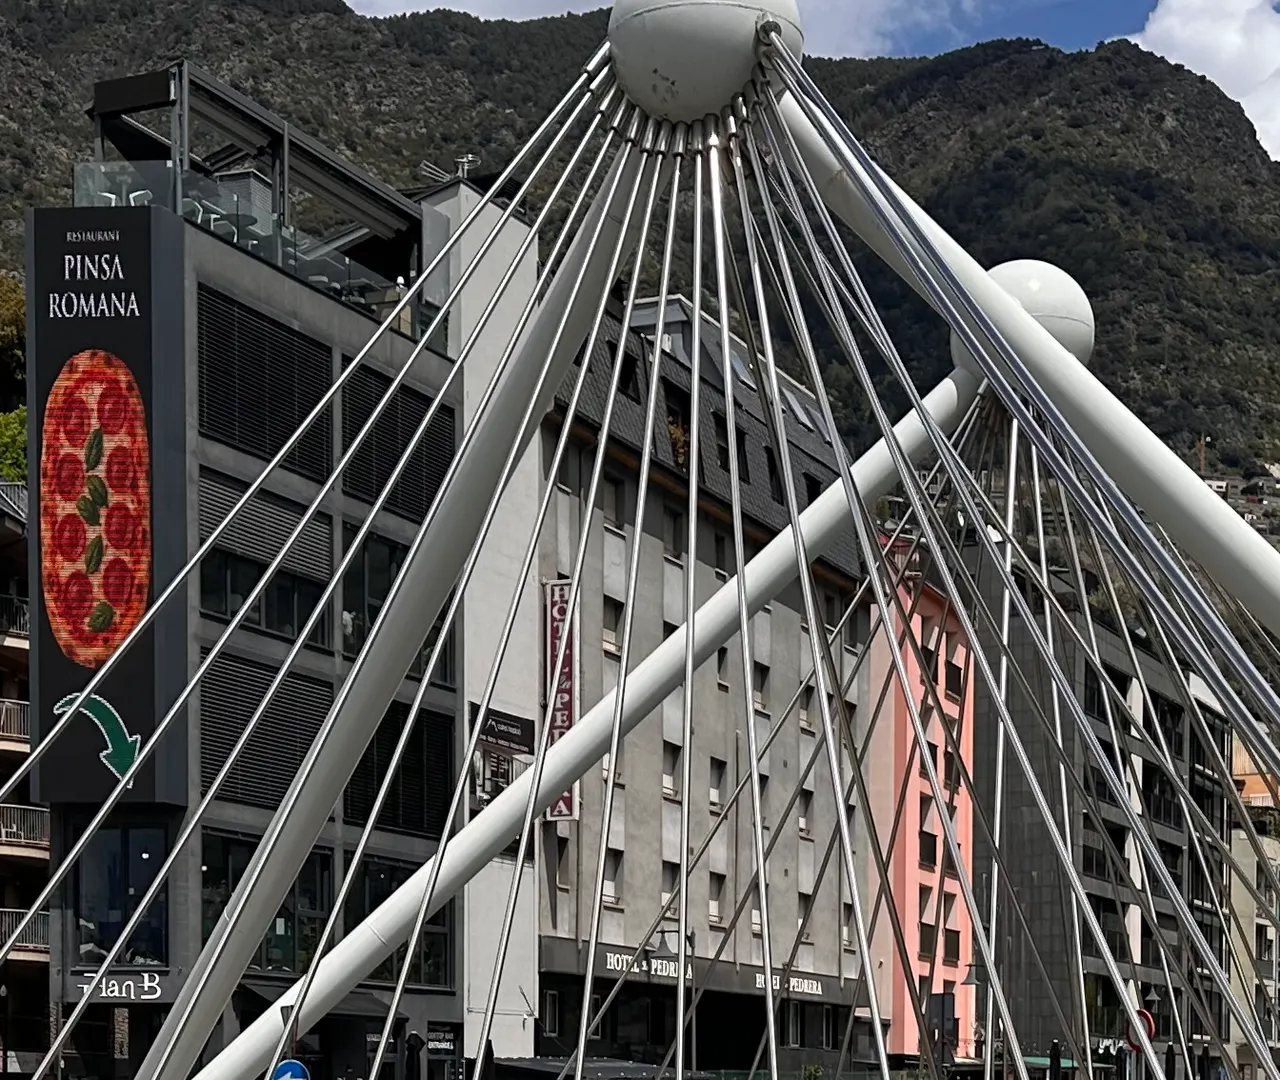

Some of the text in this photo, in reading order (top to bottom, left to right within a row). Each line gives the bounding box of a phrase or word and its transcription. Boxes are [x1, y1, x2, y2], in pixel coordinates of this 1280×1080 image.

[67, 231, 120, 242] RESTAURANT
[64, 254, 125, 280] PINSA
[49, 291, 140, 318] ROMANA
[137, 972, 162, 1000] B
[789, 976, 823, 995] PEDRERA
